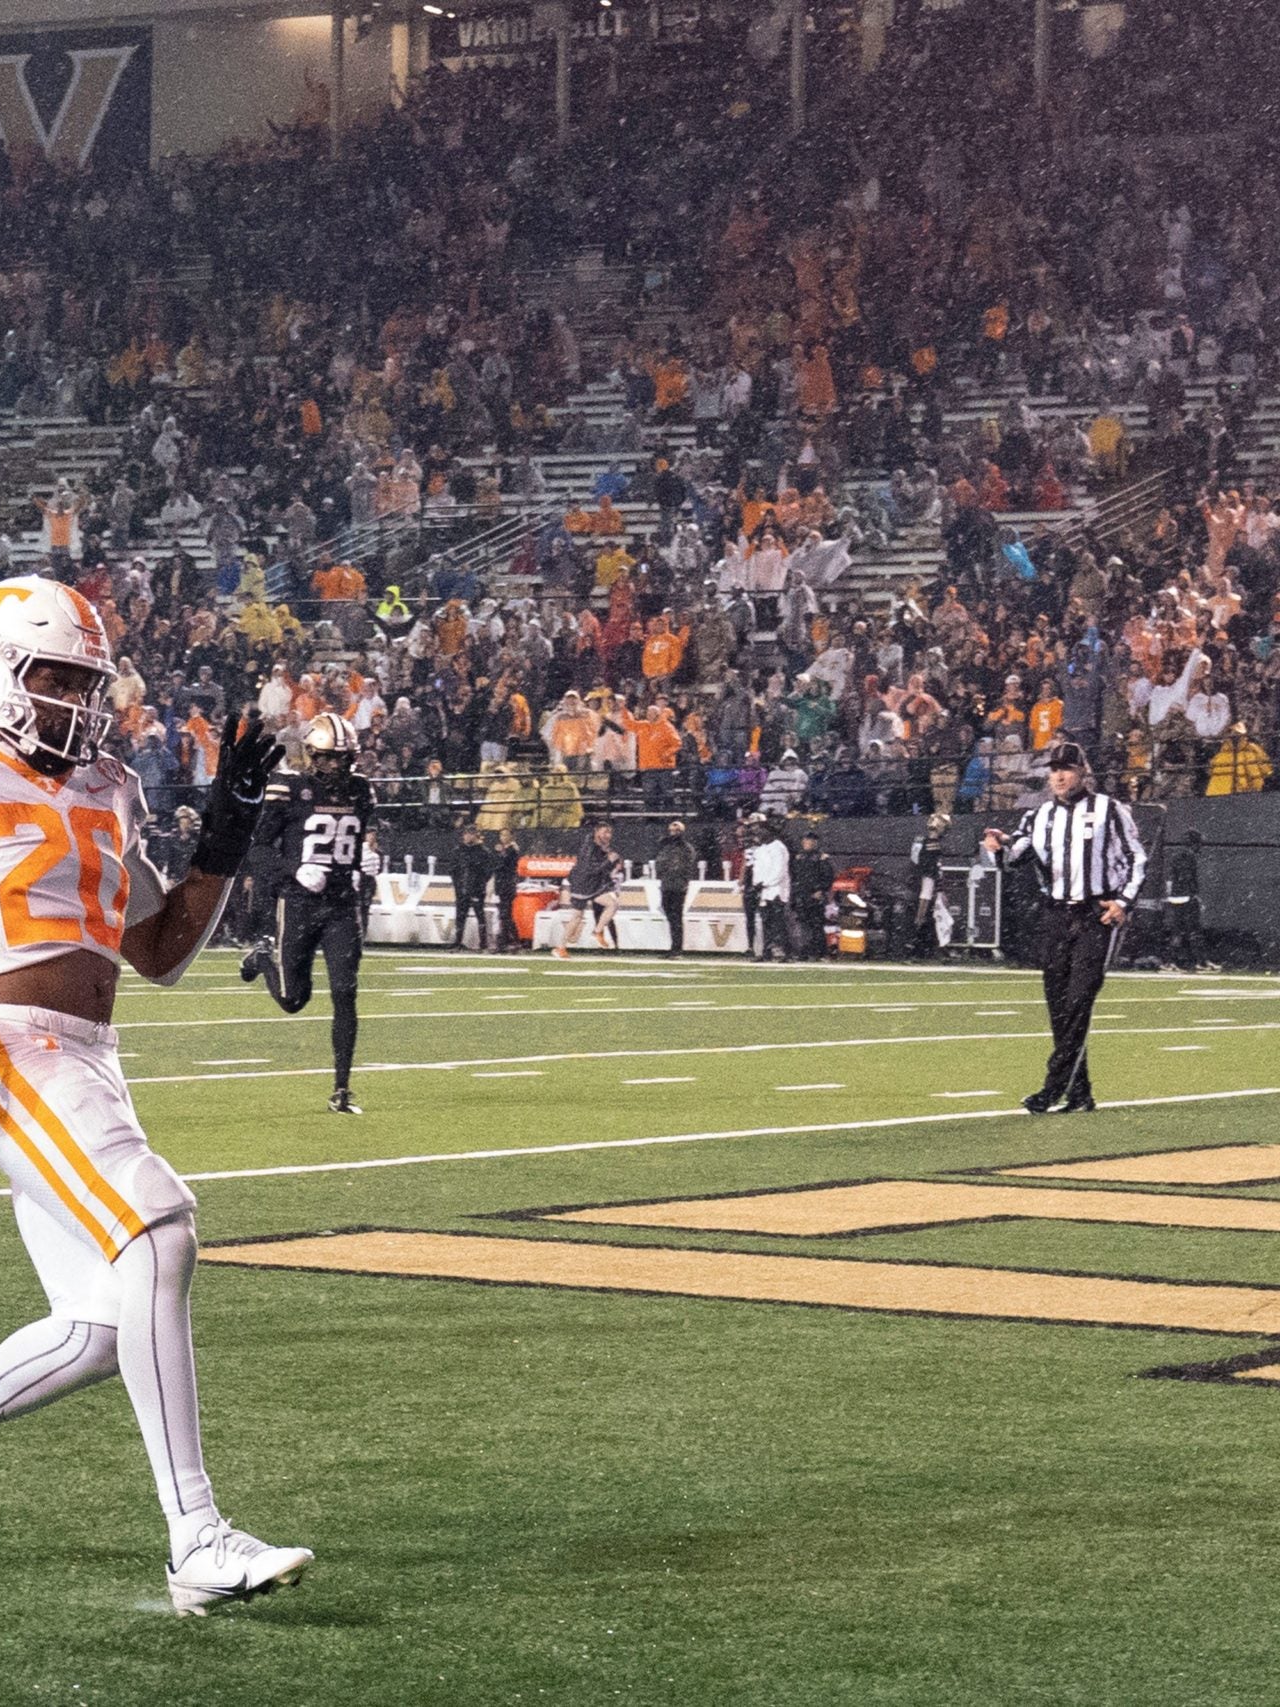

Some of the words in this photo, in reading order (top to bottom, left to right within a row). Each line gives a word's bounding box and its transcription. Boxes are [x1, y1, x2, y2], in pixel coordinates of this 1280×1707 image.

[1038, 710, 1051, 732] 5
[301, 813, 361, 864] 26
[708, 924, 735, 948] V
